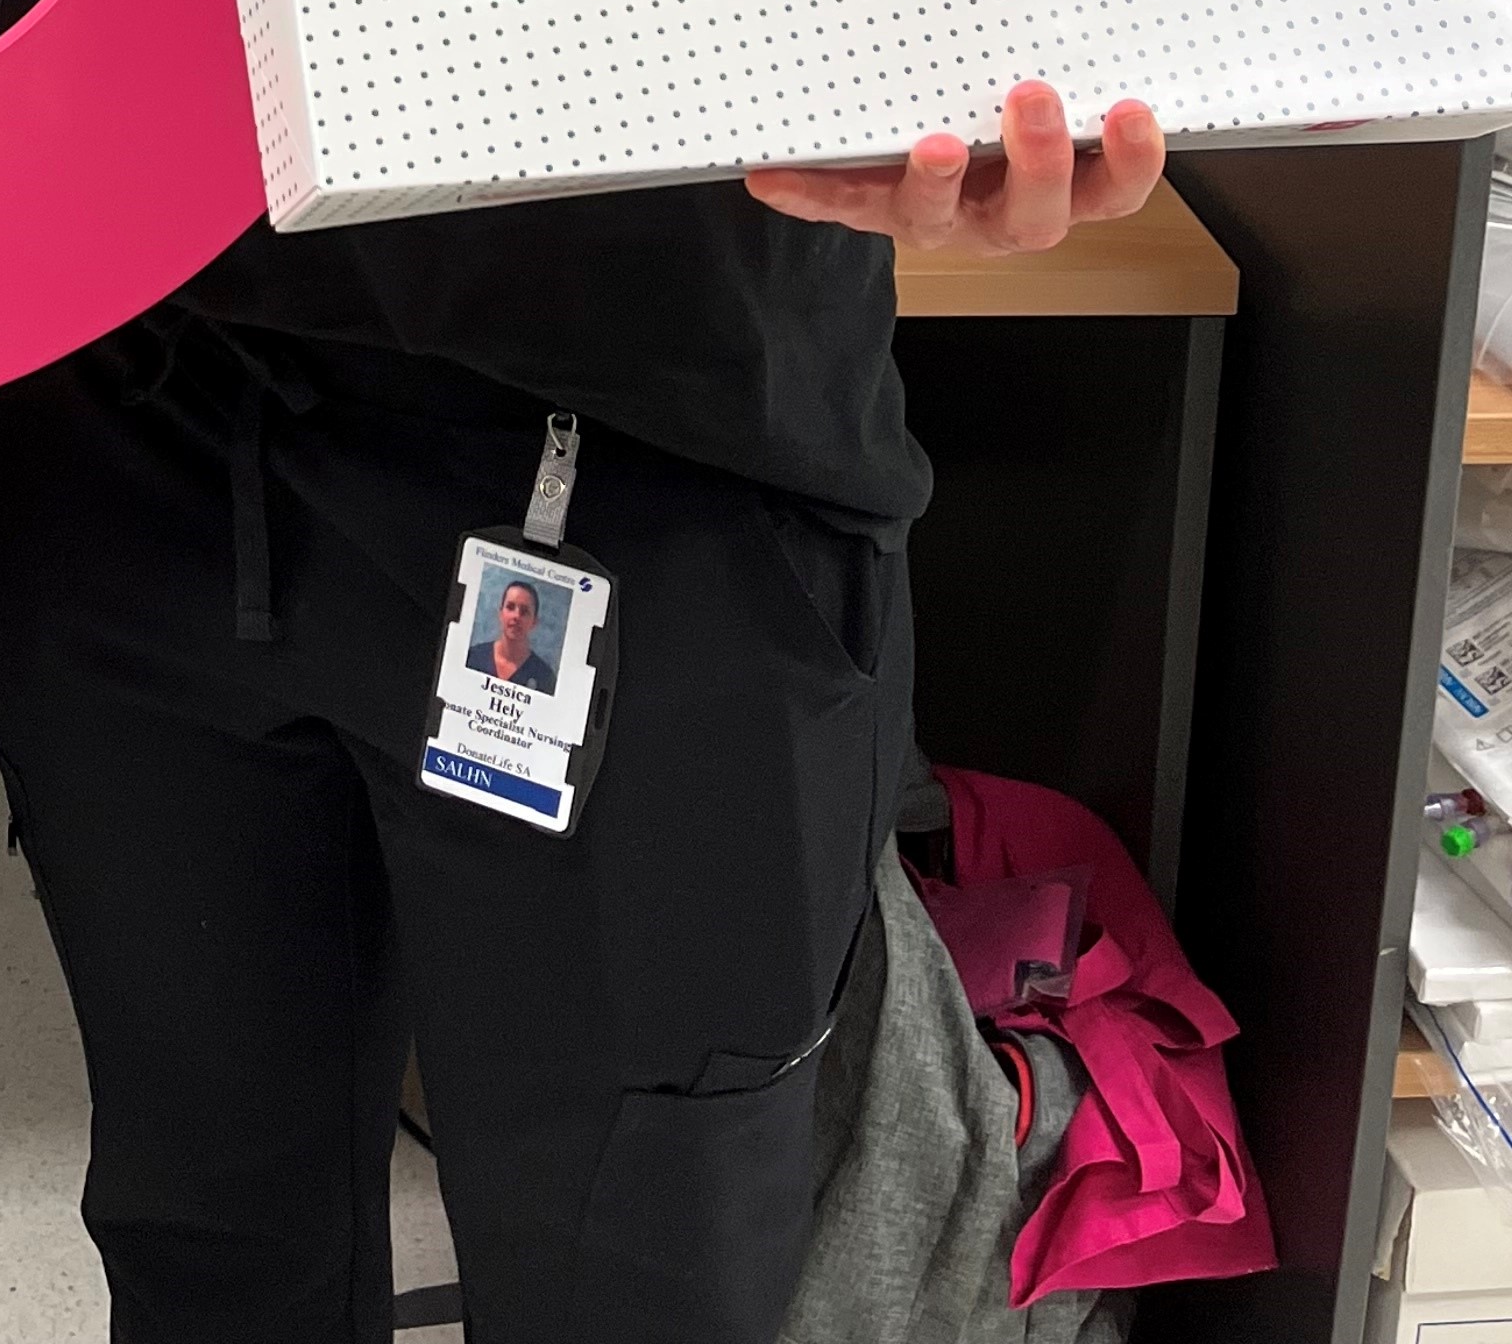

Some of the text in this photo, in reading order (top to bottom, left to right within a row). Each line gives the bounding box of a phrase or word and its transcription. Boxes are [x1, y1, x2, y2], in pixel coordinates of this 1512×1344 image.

[476, 546, 509, 564] Flinders
[512, 557, 546, 576] Medical
[481, 677, 532, 705] Jessica
[489, 697, 524, 724] Hely
[468, 719, 533, 750] Coordinator
[475, 709, 526, 735] Specialist
[528, 727, 573, 753] Nursing
[435, 755, 493, 788] SALHN
[457, 742, 531, 778] DonateLife SA
